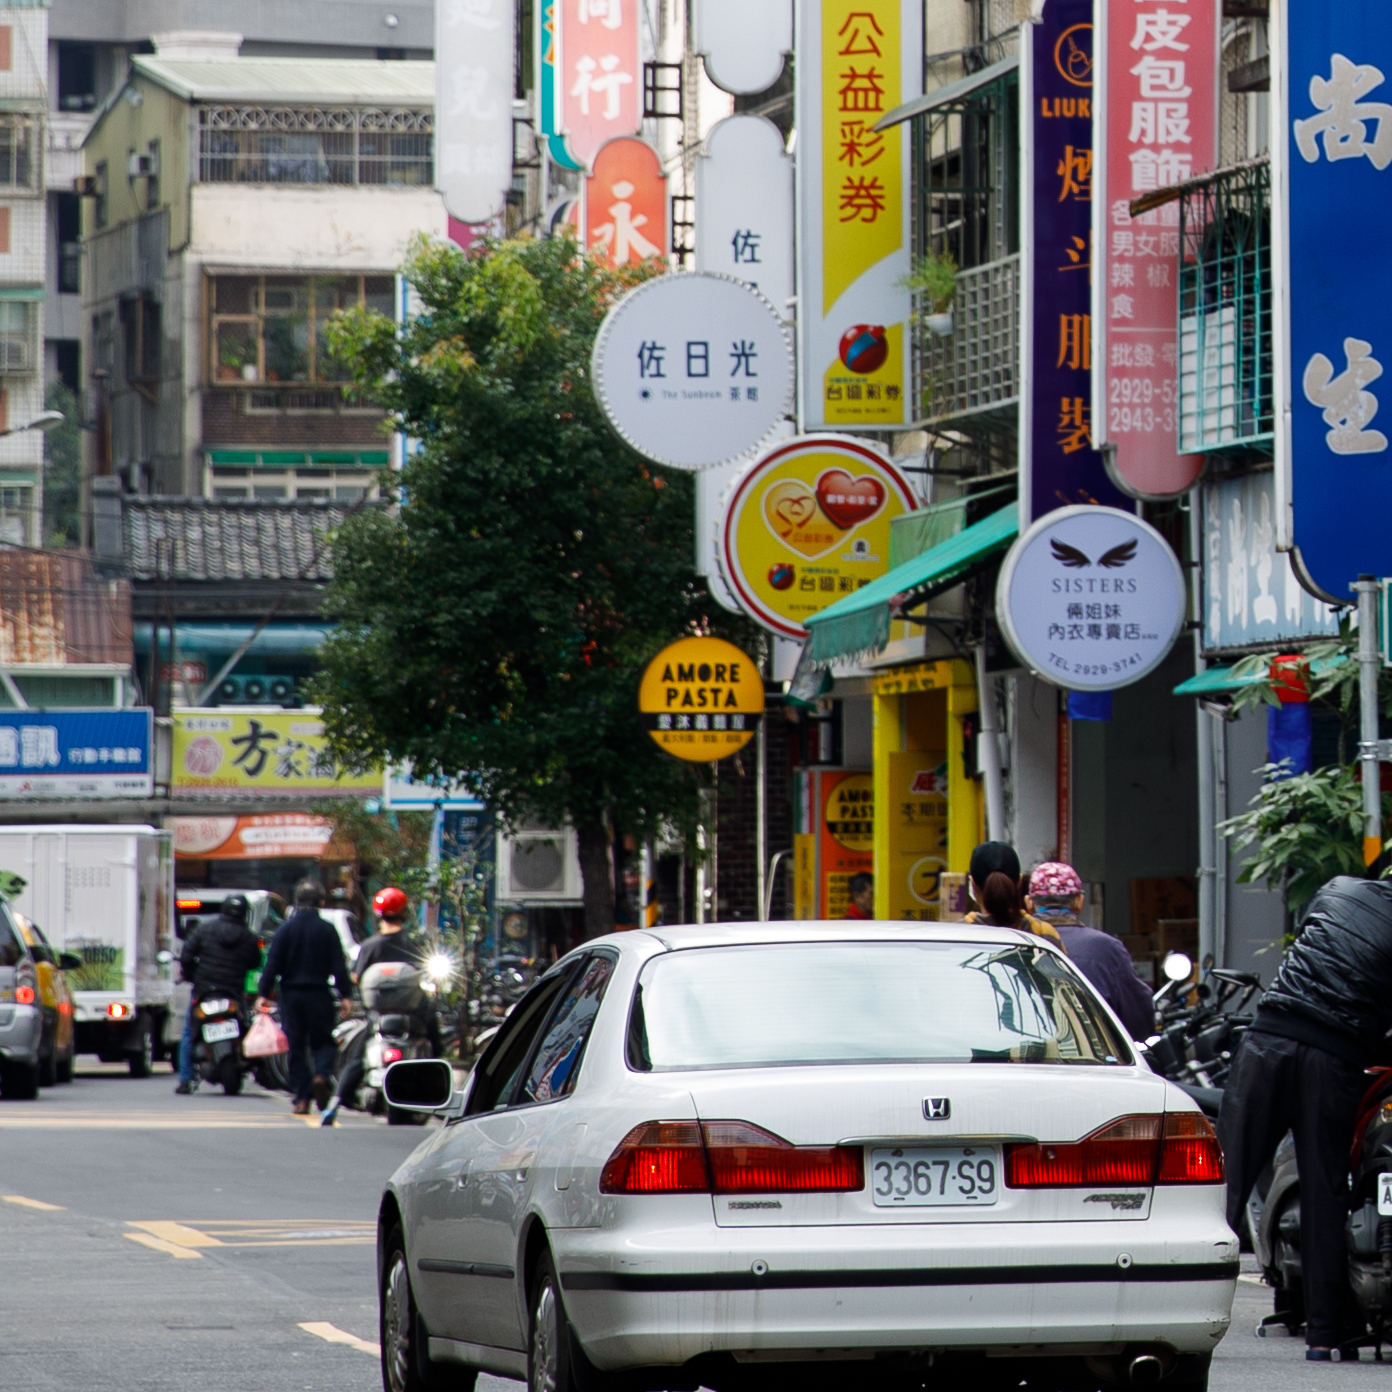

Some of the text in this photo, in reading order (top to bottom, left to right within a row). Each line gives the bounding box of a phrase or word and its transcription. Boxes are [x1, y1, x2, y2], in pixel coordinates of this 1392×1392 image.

[838, 11, 886, 224] 公益彩券
[1041, 97, 1092, 118] LIUK
[731, 229, 762, 265] 佐
[637, 340, 758, 378] 佐日光
[1052, 578, 1137, 593] SISTERS
[1067, 602, 1122, 621] 倆姐妹
[1048, 622, 1142, 641] 內衣專賣店
[1049, 653, 1070, 671] TEL
[661, 663, 740, 683] AMORE
[666, 687, 738, 708] PASTA
[838, 789, 874, 803] AMO
